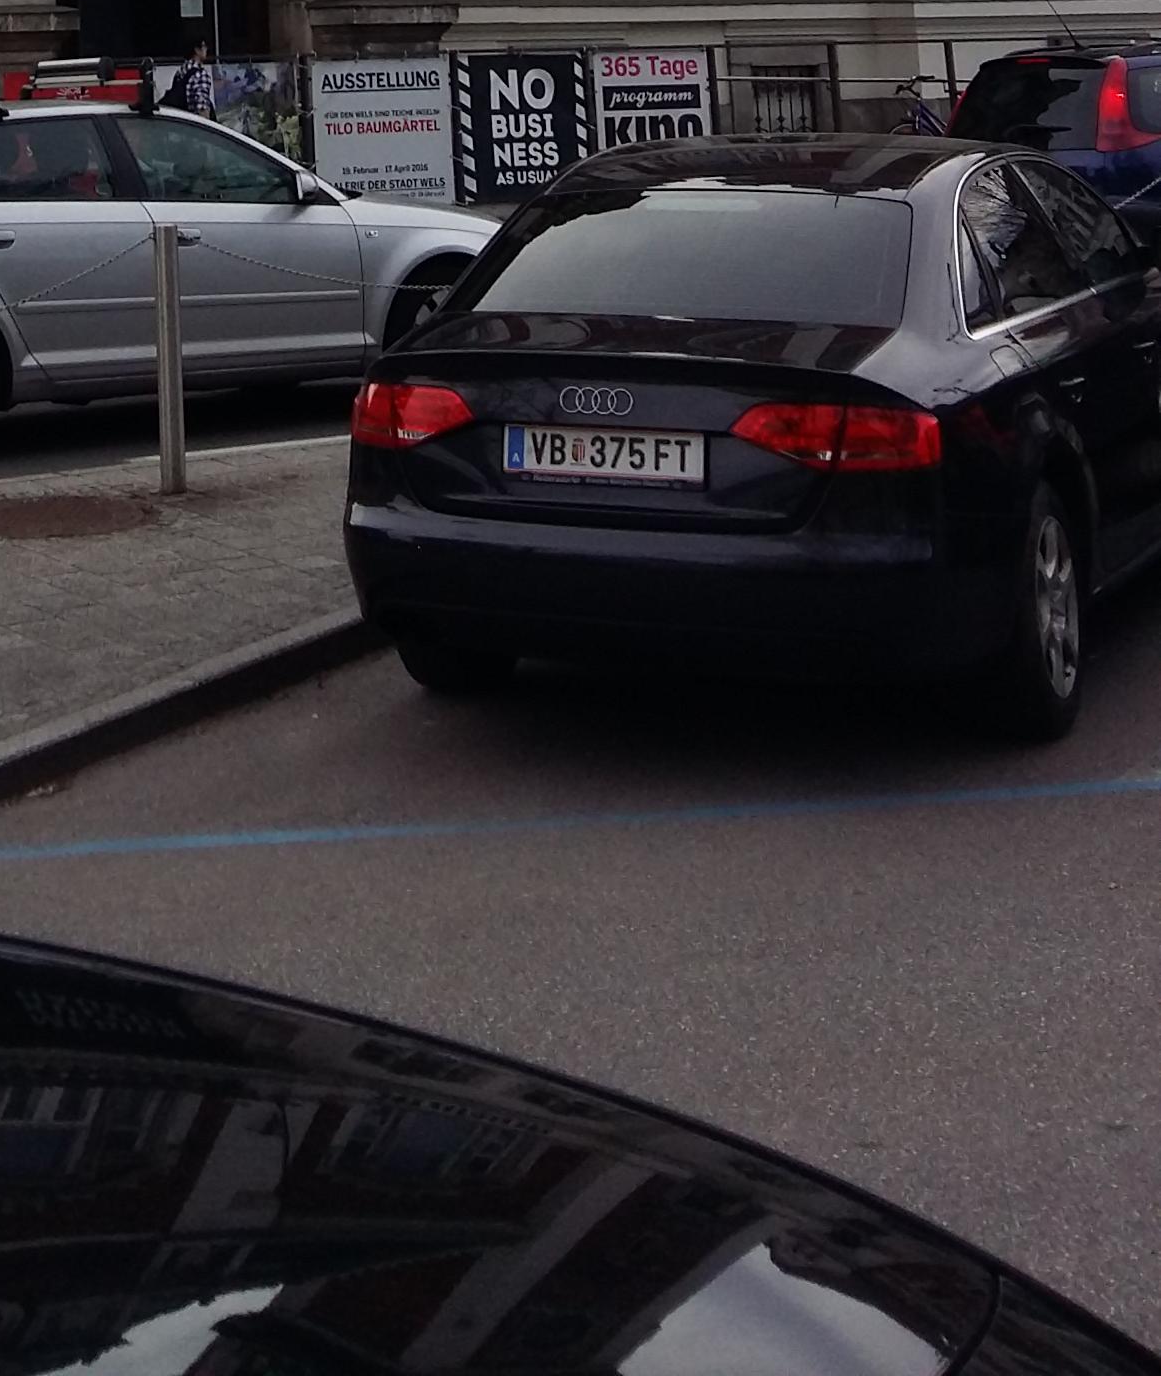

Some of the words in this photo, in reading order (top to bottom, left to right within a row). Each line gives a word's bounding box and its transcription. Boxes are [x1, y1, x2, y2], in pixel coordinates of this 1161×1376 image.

[601, 56, 640, 77] 365
[646, 56, 699, 80] Tage
[321, 70, 440, 90] AUSSTELLUNG
[489, 68, 555, 110] NO
[608, 91, 694, 109] programm
[325, 122, 353, 136] TILO
[357, 118, 440, 134] BAUMGÄRTEL
[491, 113, 554, 139] BUSI
[492, 141, 560, 168] NESS
[368, 179, 387, 189] DER
[389, 178, 418, 189] STADT
[420, 177, 446, 187] WELS
[495, 171, 515, 185] AS
[517, 170, 558, 185] USUA
[512, 452, 521, 463] A
[531, 432, 567, 465] VB
